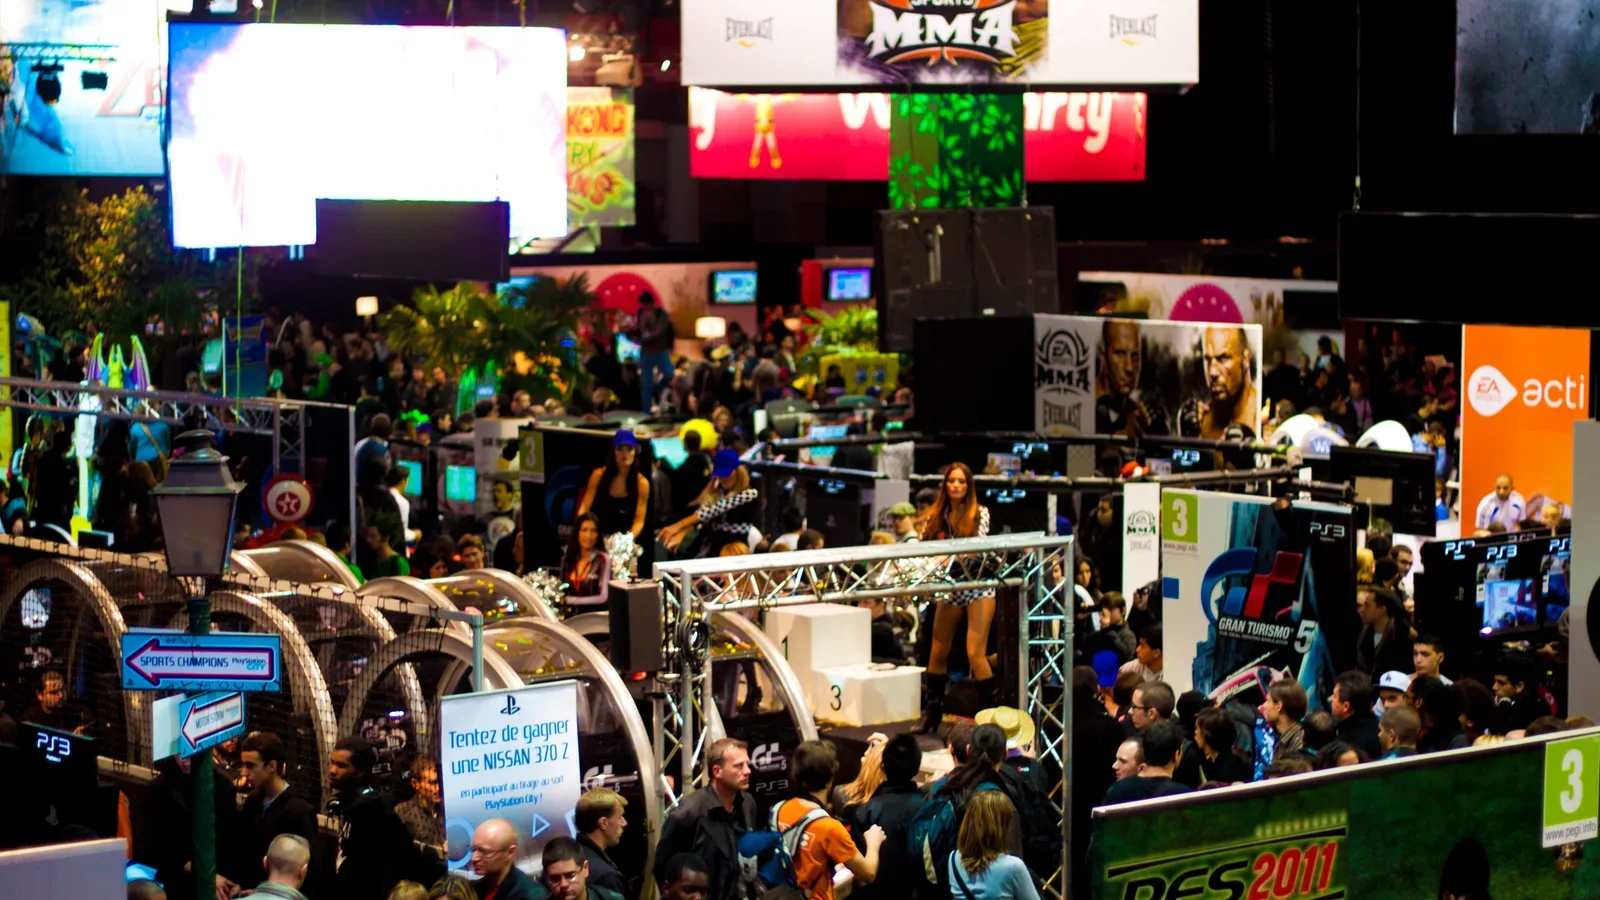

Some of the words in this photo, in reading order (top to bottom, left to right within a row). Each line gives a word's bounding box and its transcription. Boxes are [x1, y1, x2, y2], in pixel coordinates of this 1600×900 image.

[725, 17, 774, 41] EVERLAST
[864, 0, 1020, 57] MMA
[1109, 13, 1158, 40] EVERLAST
[1036, 365, 1090, 393] MMA
[1523, 374, 1585, 410] acti
[1043, 399, 1082, 429] EVERLAST
[1172, 499, 1188, 537] 3
[1310, 521, 1345, 537] PS3
[1486, 544, 1518, 560] PS3
[1549, 537, 1572, 552] PS
[1218, 618, 1246, 633] GRAN
[1247, 621, 1291, 640] TURISMO
[1294, 619, 1316, 654] 5
[140, 656, 174, 667] SPORTS
[177, 657, 229, 668] CHAMPIONS
[830, 685, 842, 711] 3
[37, 732, 71, 756] PS3
[449, 729, 497, 749] Tentez
[502, 724, 518, 742] de
[523, 719, 570, 744] gagner
[451, 758, 479, 775] une
[484, 747, 531, 771] NISSAN
[535, 743, 558, 764] 370
[561, 742, 569, 760] Z
[460, 789, 470, 798] en
[472, 783, 508, 799] participant
[510, 783, 519, 791] au
[756, 779, 788, 793] PS3
[1560, 749, 1584, 813] 3
[485, 796, 524, 811] PlayStation
[1545, 822, 1597, 840] www.pegi.info
[1248, 841, 1338, 900] 2011
